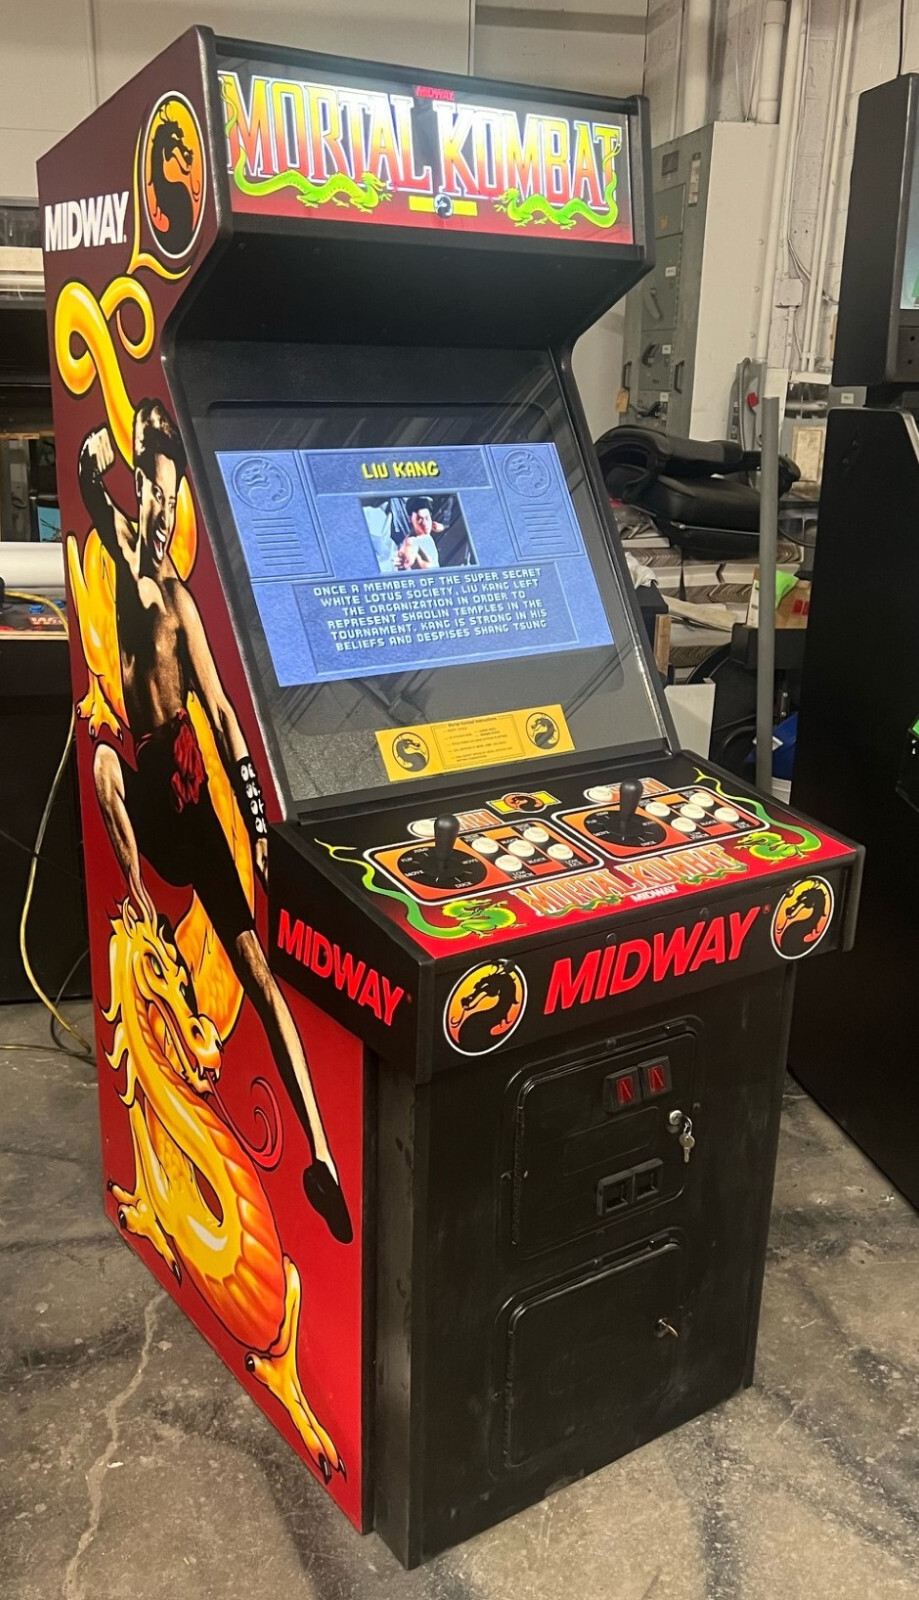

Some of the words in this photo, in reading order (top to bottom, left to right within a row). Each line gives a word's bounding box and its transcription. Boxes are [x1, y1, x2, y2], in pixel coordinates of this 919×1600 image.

[415, 85, 455, 101] MIDWAY
[217, 70, 432, 194] MORTAL
[432, 100, 622, 212] KOMBAT
[361, 462, 389, 480] LIU
[392, 460, 440, 478] KANG
[313, 584, 347, 597] ONCE
[351, 584, 360, 594] A
[363, 579, 416, 592] MEMBER
[419, 577, 435, 588] OF
[439, 575, 461, 586] THE
[464, 571, 499, 584] SUPER
[502, 568, 541, 580] SECRET
[320, 595, 361, 608] WHITE
[364, 591, 403, 604] LOTUS
[461, 584, 478, 594] LIU
[482, 581, 510, 592] KANG
[513, 578, 539, 589] LEFT
[327, 614, 397, 630] REPRESENT
[401, 608, 450, 622] SHAOLIN
[453, 603, 504, 617] TEMPLES
[507, 601, 519, 611] IN
[522, 599, 543, 610] THE
[342, 605, 366, 617] THE
[369, 597, 454, 614] ORGANIZATION
[457, 595, 469, 606] IN
[472, 592, 509, 604] ORDER
[511, 590, 526, 600] TO
[421, 619, 451, 632] KANG
[454, 617, 466, 628] IS
[469, 612, 512, 626] STRONG
[515, 610, 527, 621] IN
[530, 608, 547, 619] HIS
[336, 638, 385, 651] BELIEFS
[389, 635, 413, 646] AND
[416, 628, 470, 643] DESPISES
[474, 623, 509, 636] SHANG
[513, 619, 547, 632] TSUNG
[509, 868, 641, 916] MORTAL
[614, 843, 733, 890] KOMBAT
[631, 884, 679, 903] MIDWAY
